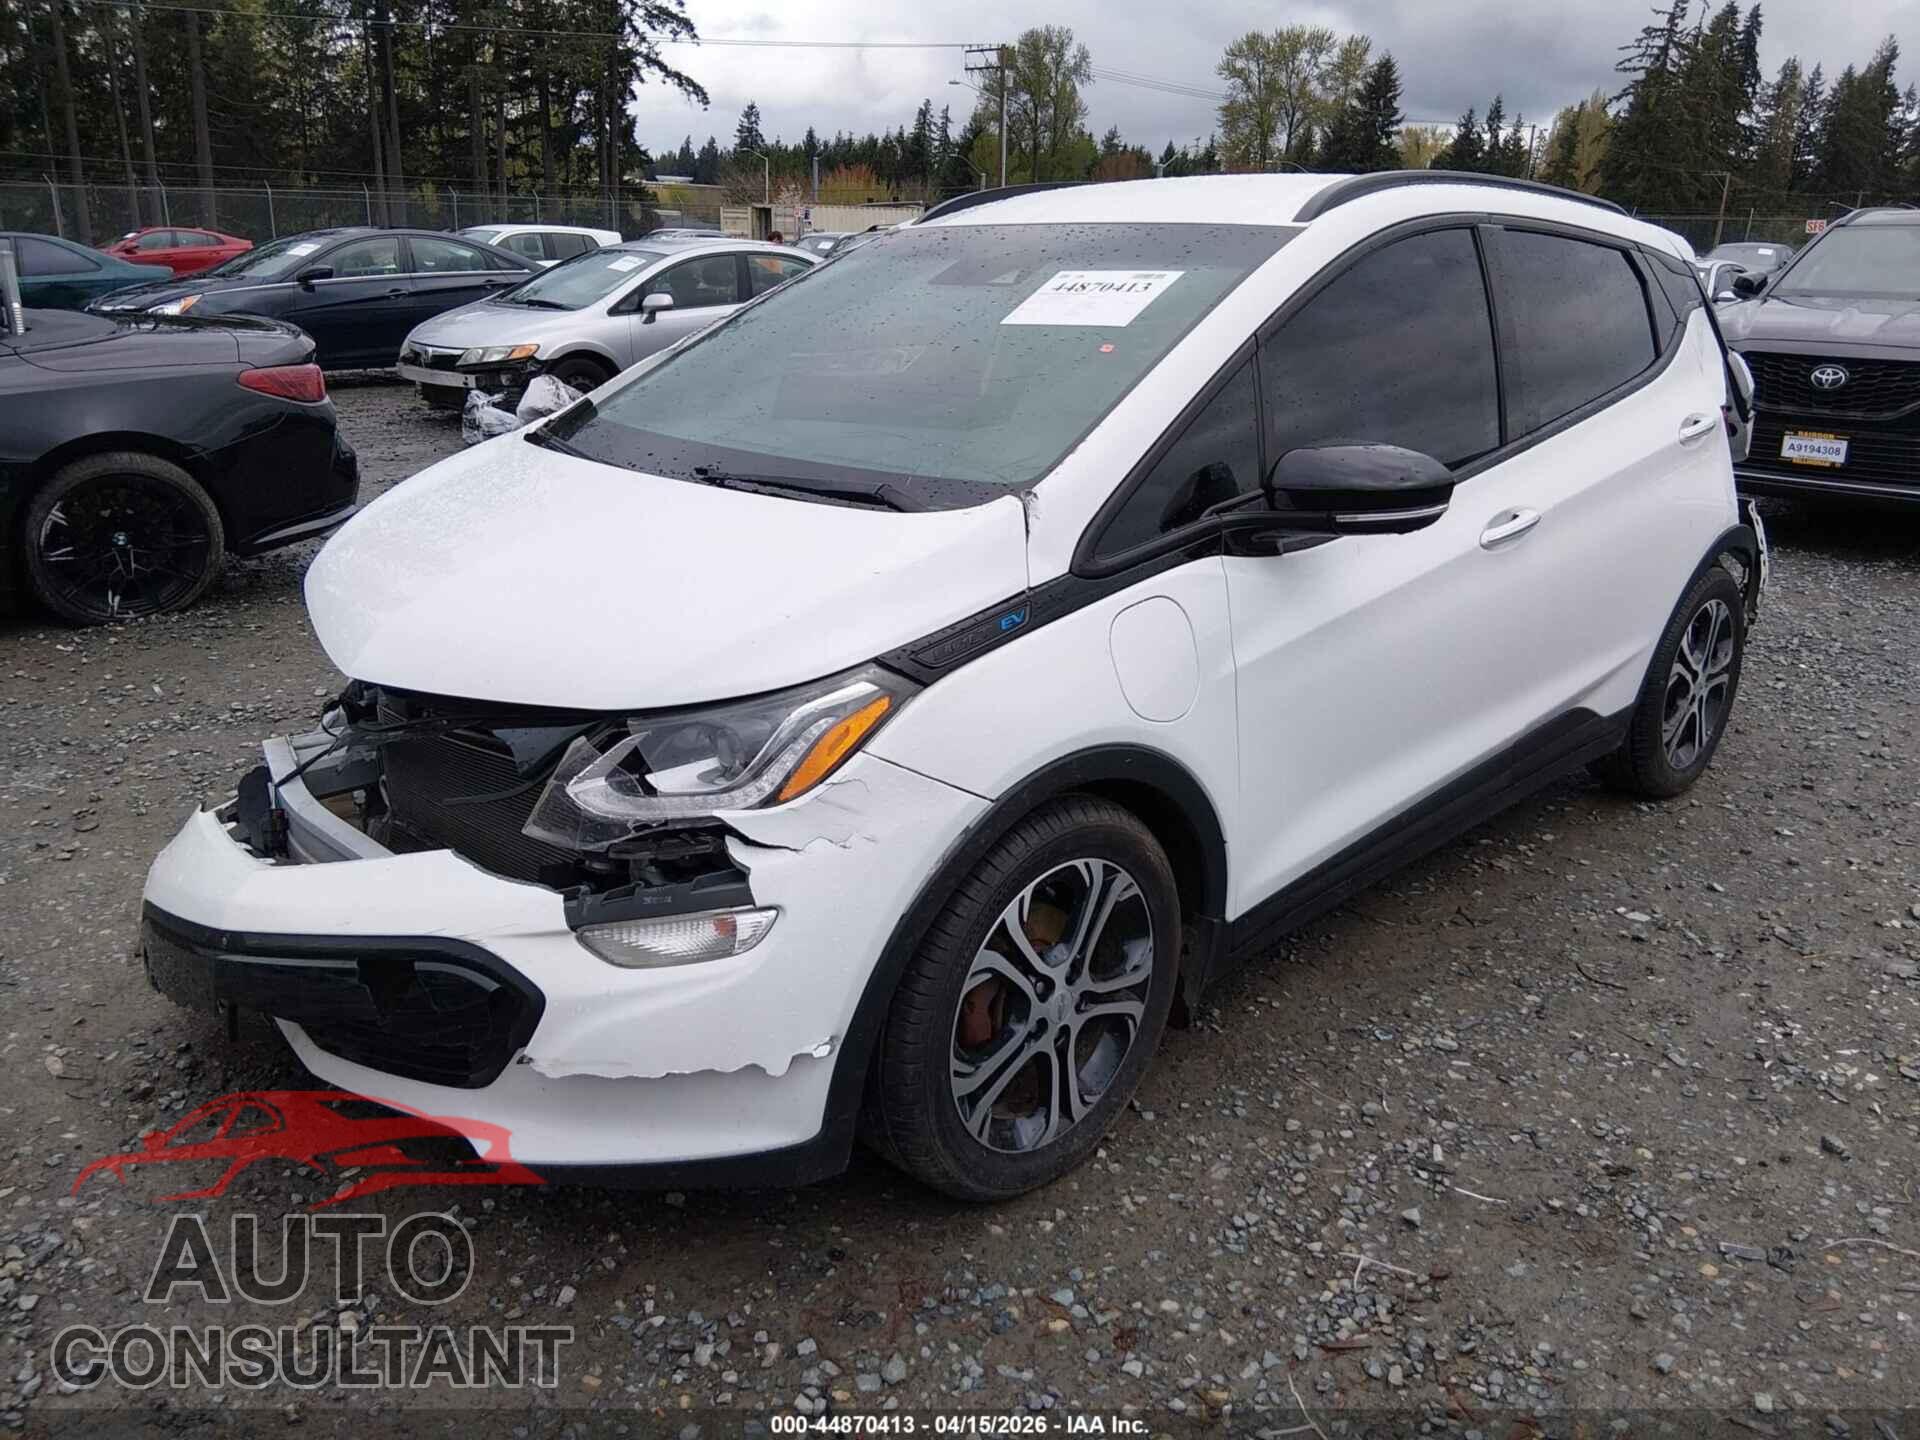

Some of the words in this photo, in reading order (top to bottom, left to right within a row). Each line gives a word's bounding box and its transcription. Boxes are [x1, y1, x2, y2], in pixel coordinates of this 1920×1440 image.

[1051, 281, 1152, 293] 44870413
[1788, 442, 1841, 456] A9194308
[1001, 608, 1025, 630] EV
